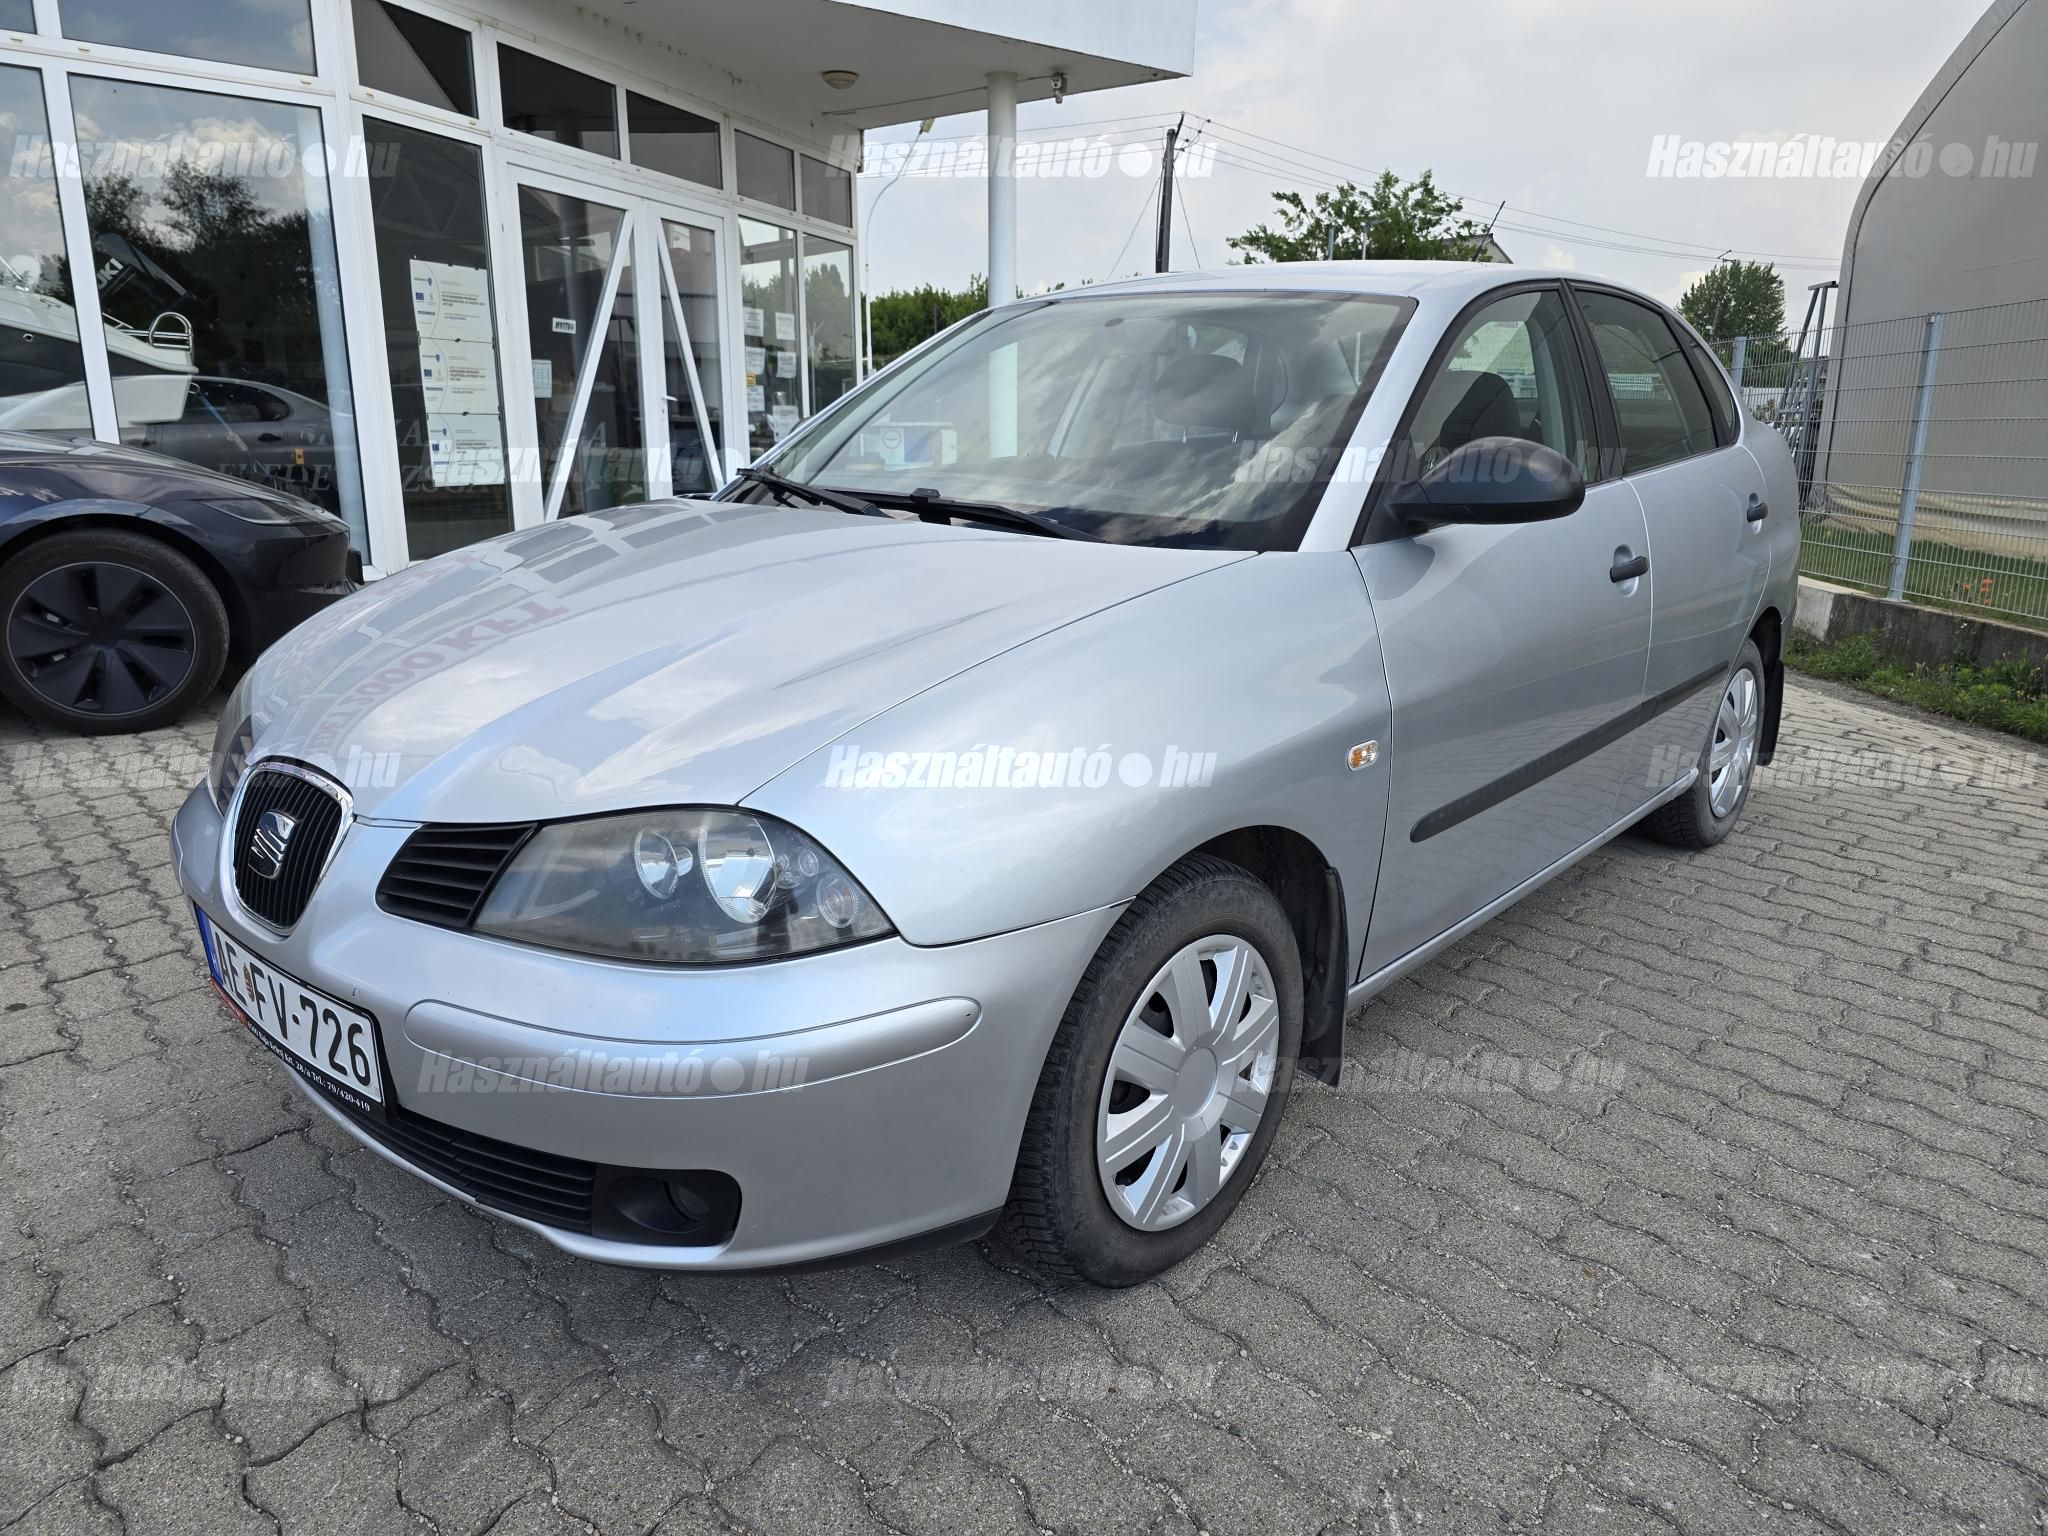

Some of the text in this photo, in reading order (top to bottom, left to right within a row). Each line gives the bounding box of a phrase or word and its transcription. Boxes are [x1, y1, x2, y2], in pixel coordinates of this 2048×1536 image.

[214, 931, 248, 1007] AE
[250, 961, 371, 1087] FV-726
[326, 1081, 370, 1112] 79/420-419
